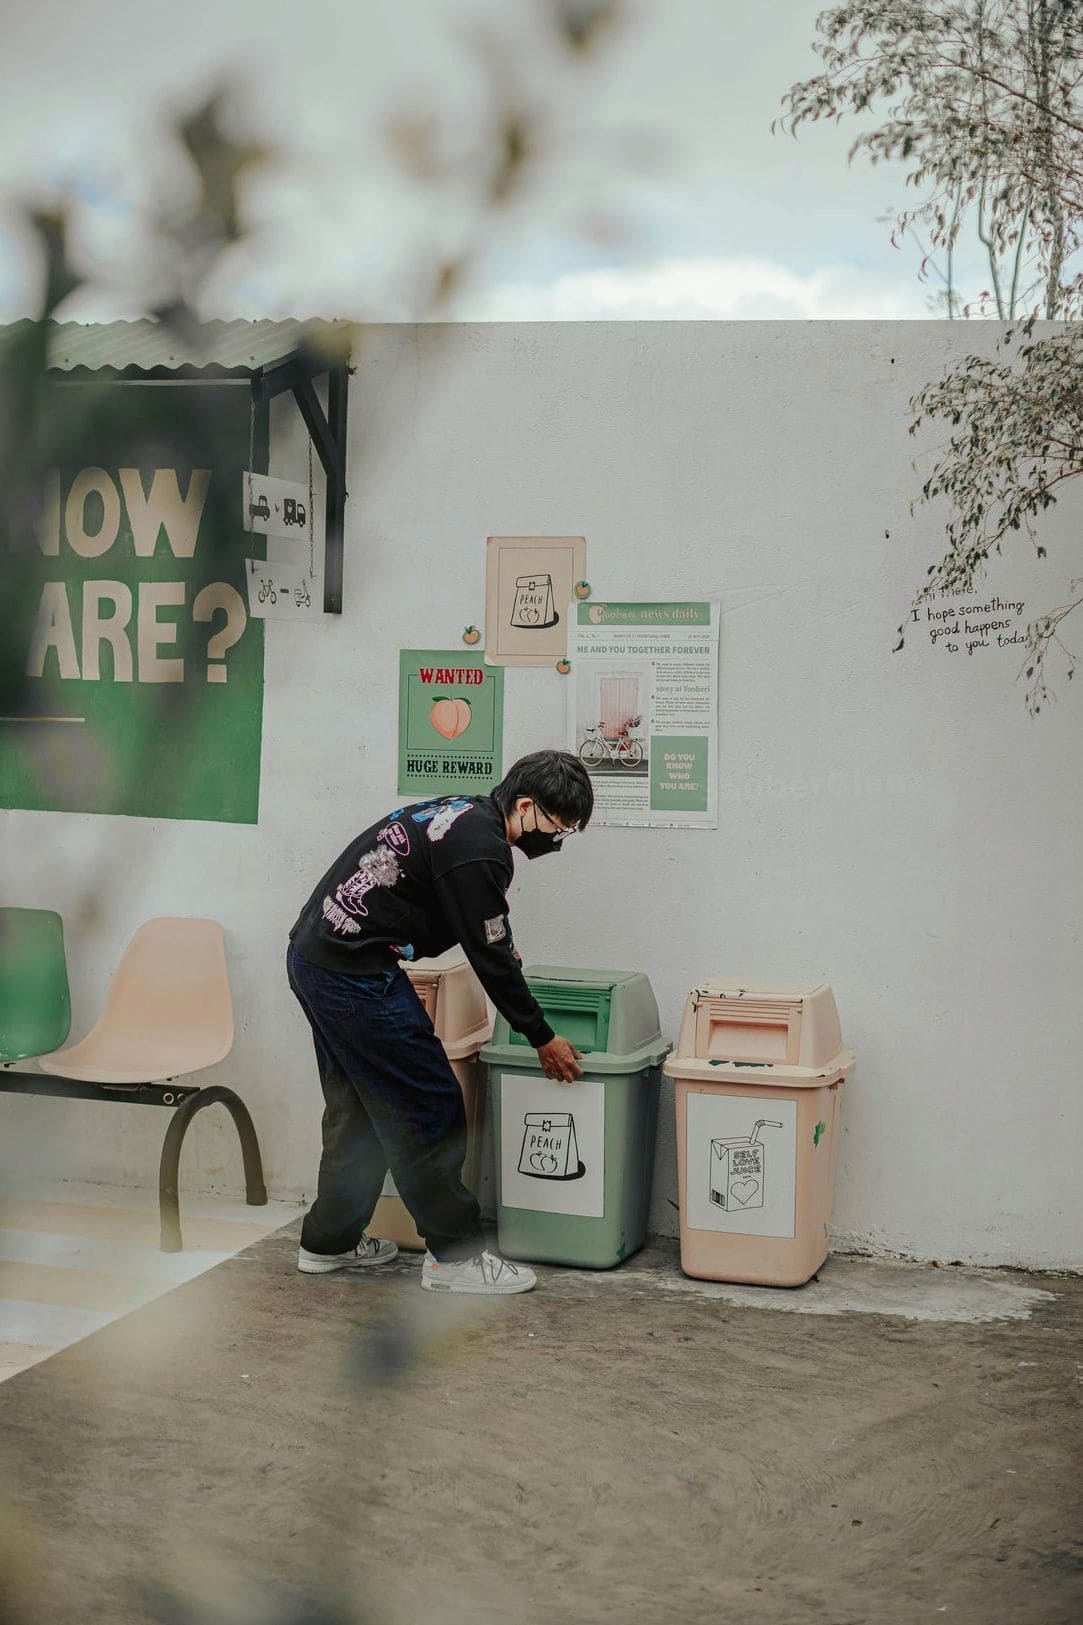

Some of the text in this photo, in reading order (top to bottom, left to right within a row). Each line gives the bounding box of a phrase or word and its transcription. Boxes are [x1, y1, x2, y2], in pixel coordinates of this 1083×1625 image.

[519, 594, 543, 605] PEACH
[640, 610, 669, 618] news
[672, 608, 698, 620] daily
[910, 597, 1025, 623] I hope something
[25, 580, 248, 684] ARE?
[929, 619, 1012, 644] good happens
[577, 646, 710, 654] ME AND YOU TOGETHER FOREVER
[945, 642, 959, 653] to
[965, 639, 990, 656] you
[419, 667, 484, 685] WANTED
[677, 753, 695, 761] YOU
[406, 759, 493, 776] HUGE REWARD
[659, 782, 676, 790] YOU
[530, 1135, 562, 1150] PEACH
[732, 1149, 759, 1160] SELF
[732, 1156, 761, 1168] LOVE
[730, 1165, 762, 1175] JUICE
